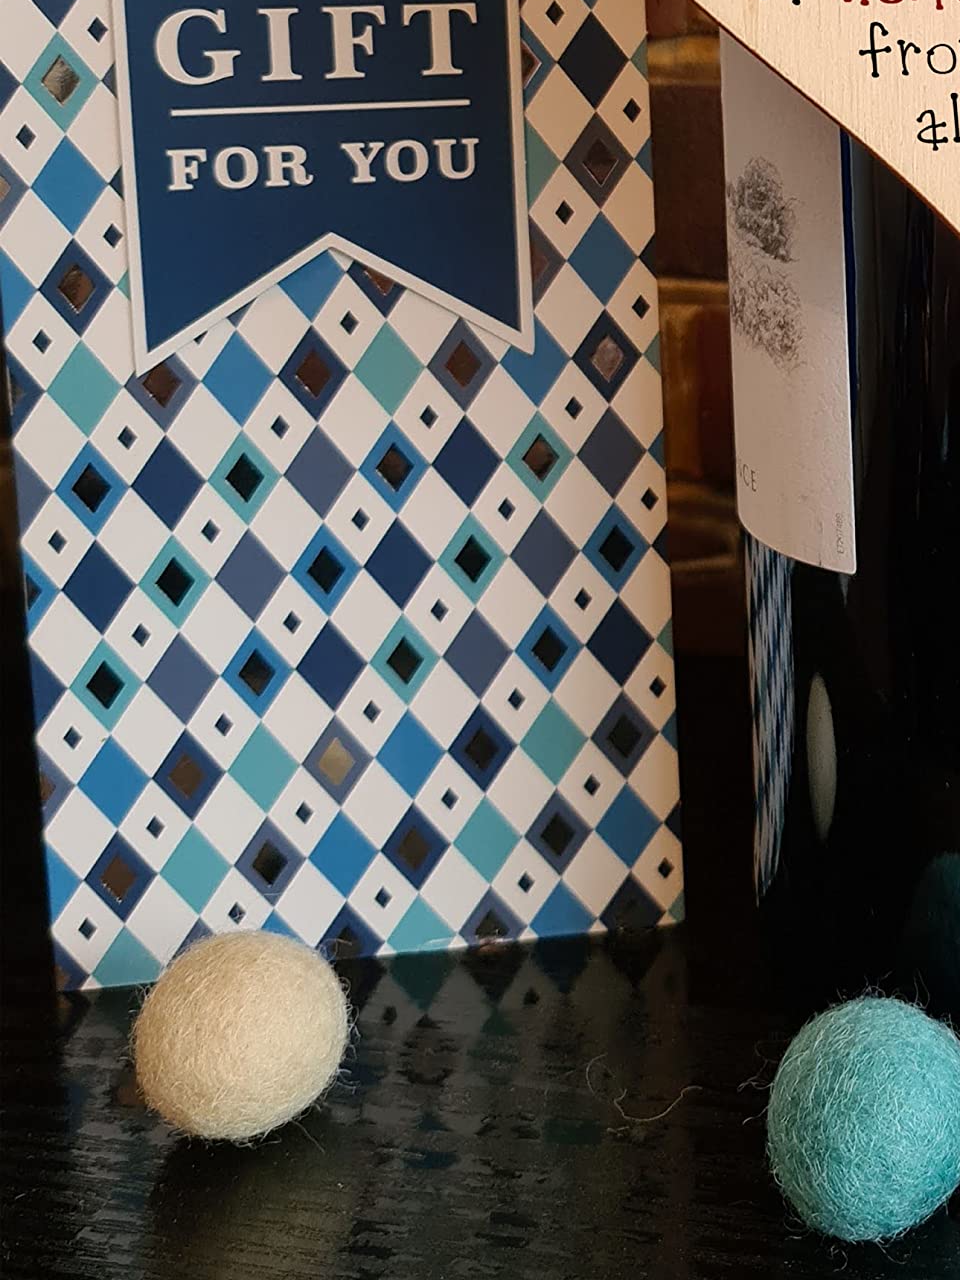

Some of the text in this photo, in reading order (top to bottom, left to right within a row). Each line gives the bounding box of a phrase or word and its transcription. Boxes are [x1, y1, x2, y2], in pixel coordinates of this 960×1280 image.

[154, 1, 478, 85] GIFT
[166, 137, 480, 191] FOR YOU
